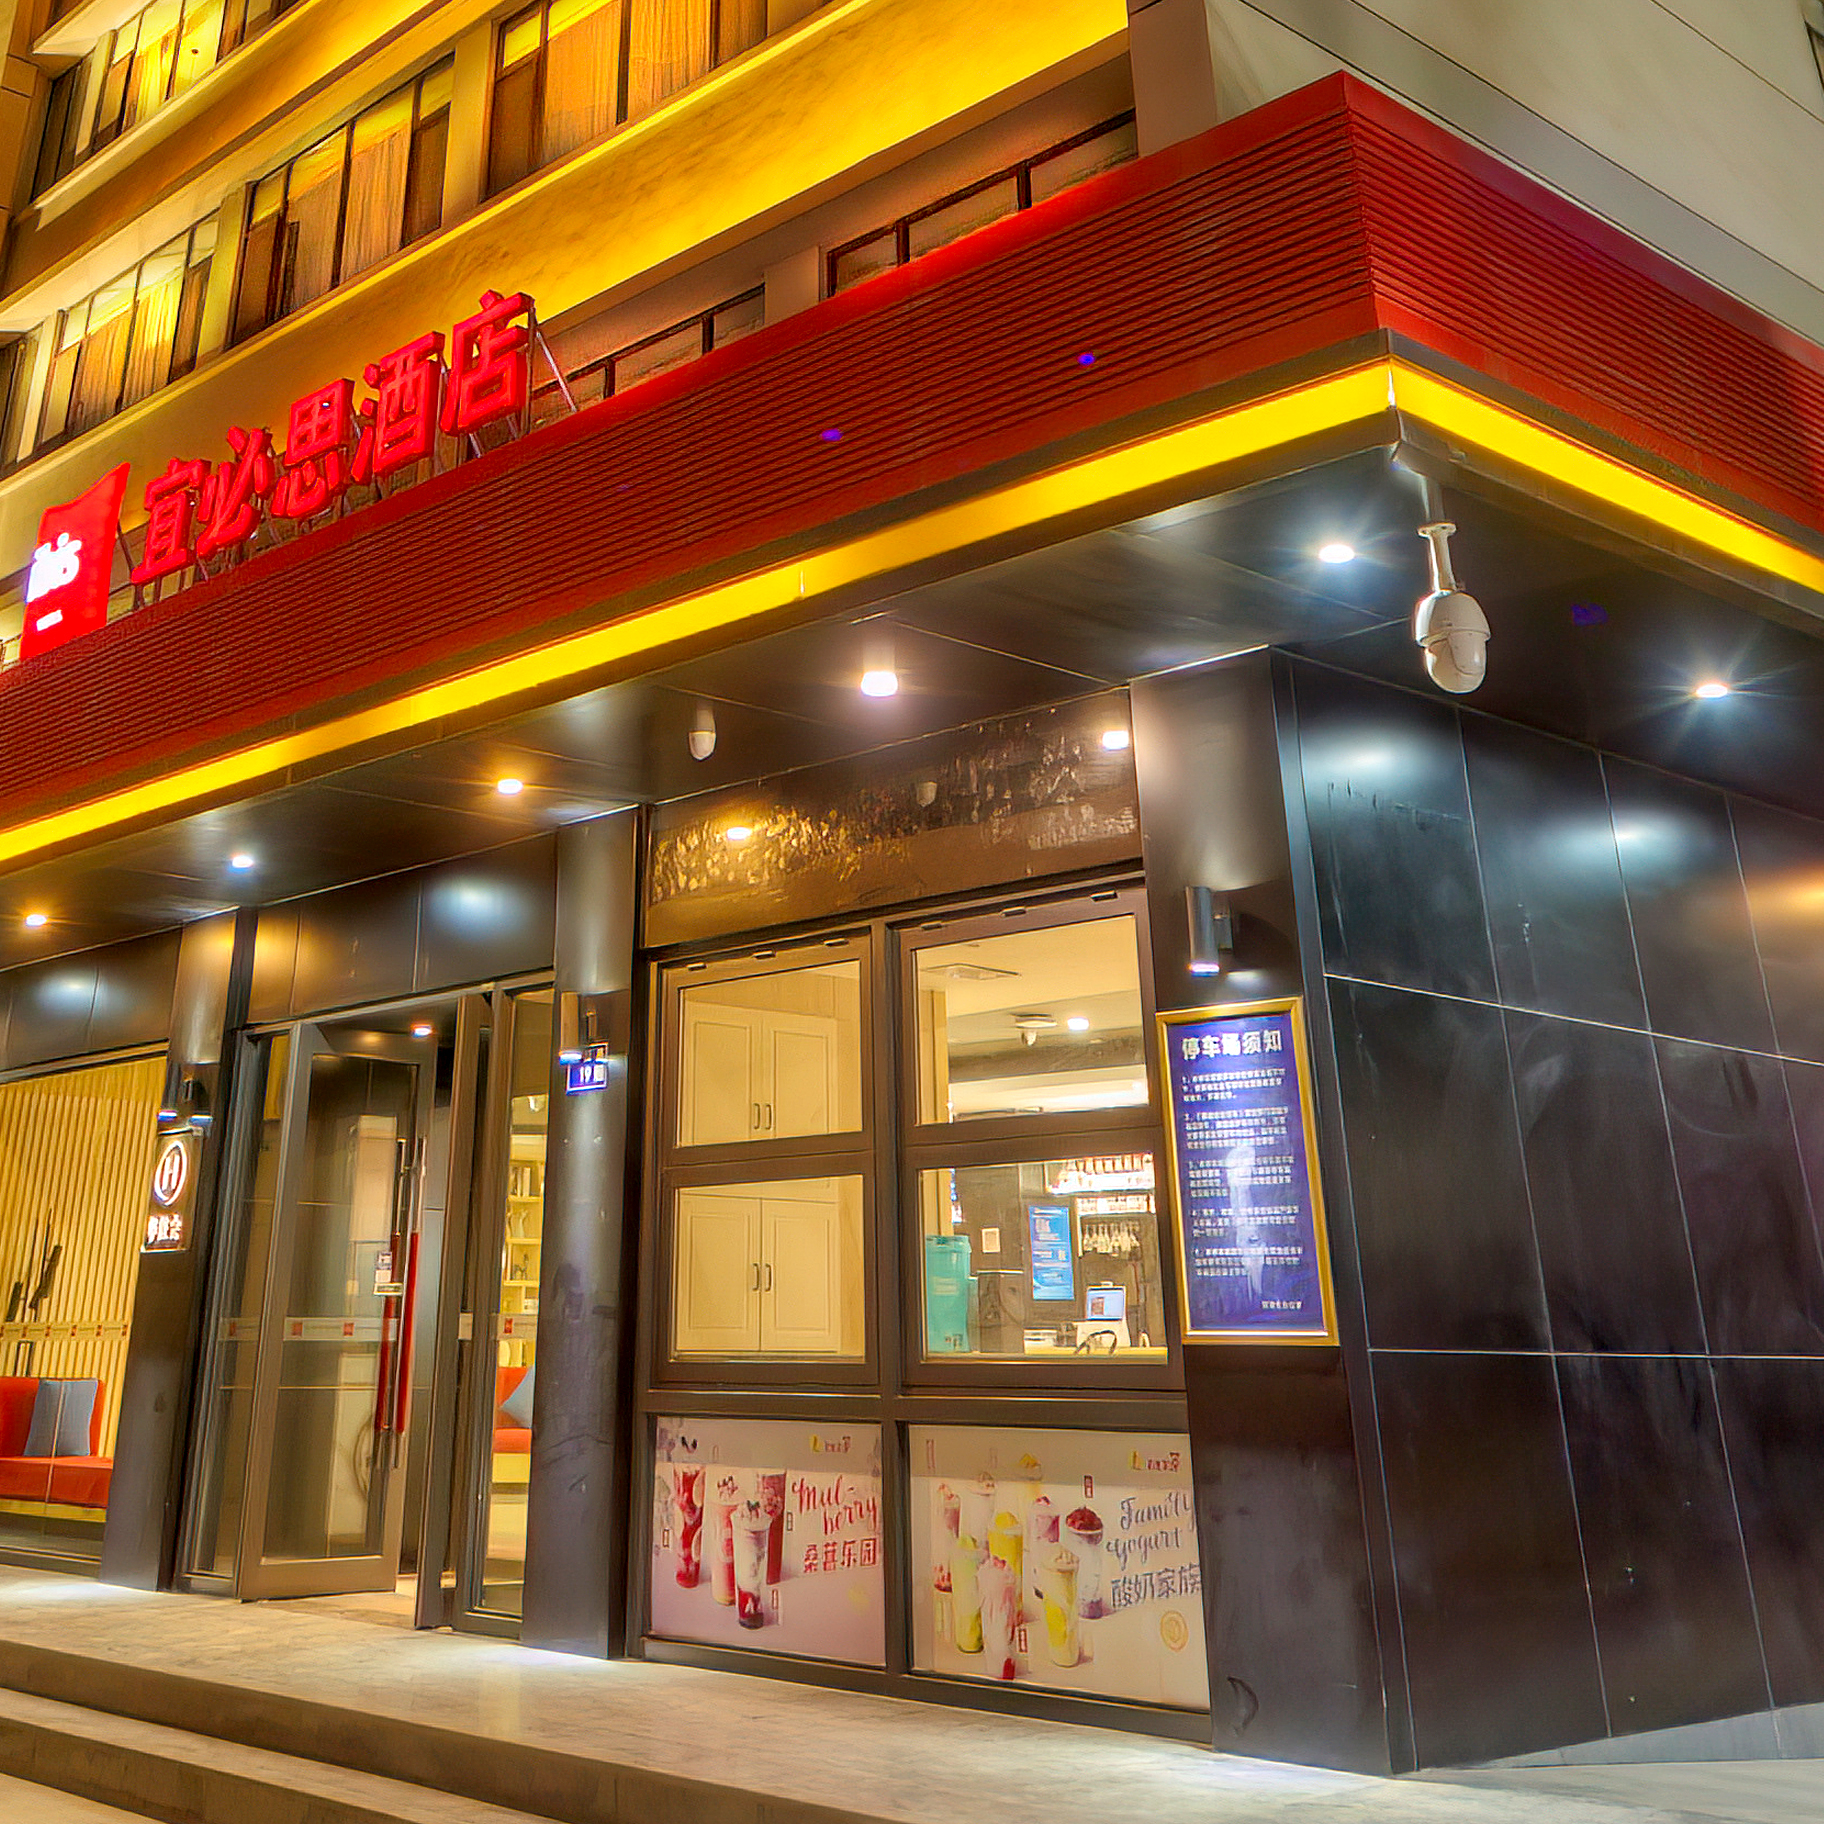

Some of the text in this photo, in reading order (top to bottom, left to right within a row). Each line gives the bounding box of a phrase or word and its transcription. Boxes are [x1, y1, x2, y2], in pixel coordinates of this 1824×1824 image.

[130, 288, 535, 586] 宜必思酒店
[1181, 1029, 1283, 1061] 停车场须知
[822, 1496, 878, 1536] berry
[1120, 1491, 1195, 1533] Family
[1110, 1562, 1202, 1610] 酸奶家族
